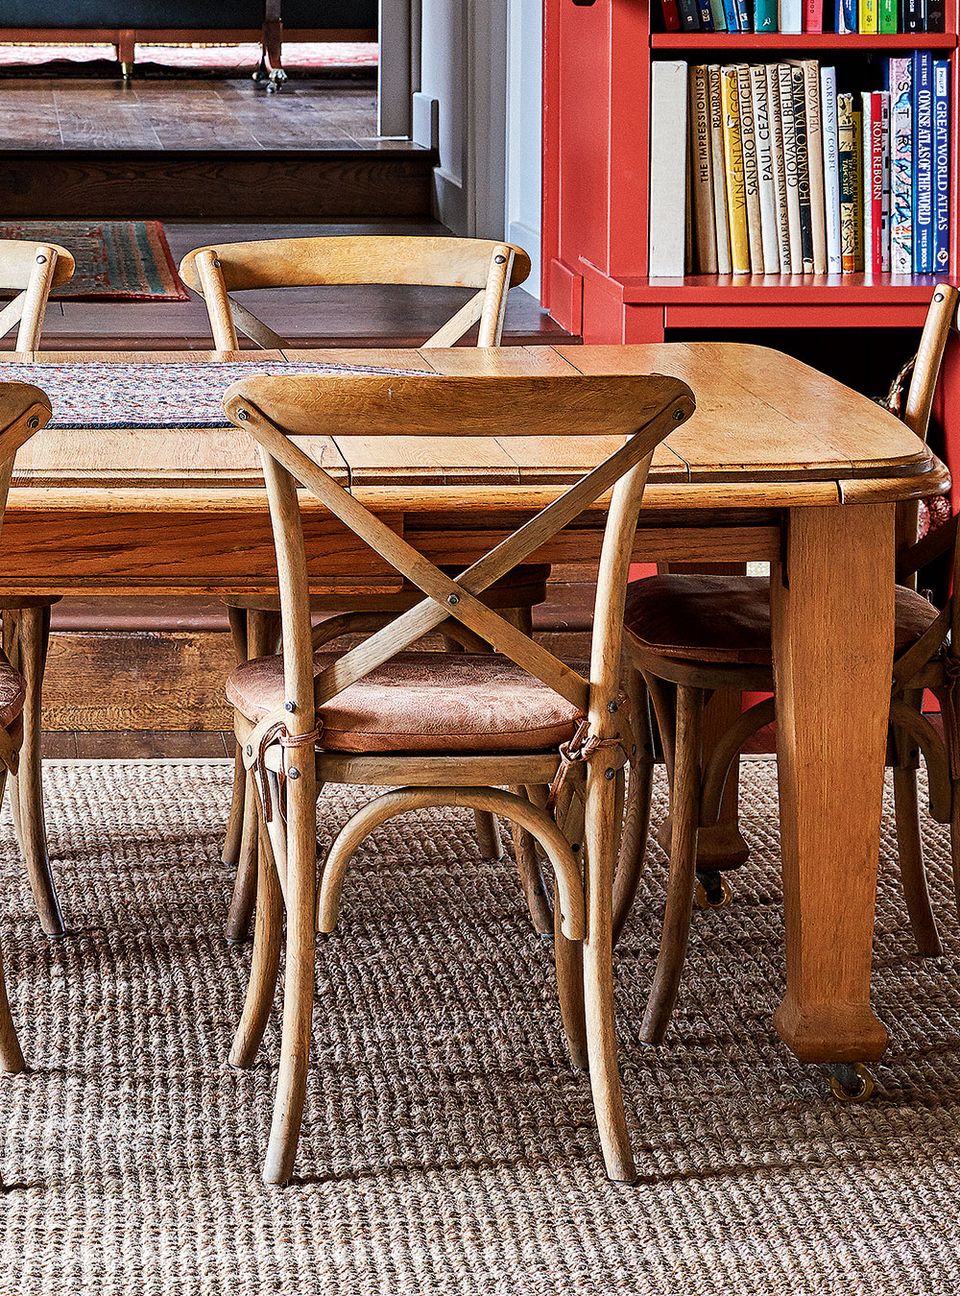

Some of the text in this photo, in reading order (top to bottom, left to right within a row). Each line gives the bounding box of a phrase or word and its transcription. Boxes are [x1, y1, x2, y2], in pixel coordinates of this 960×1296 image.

[710, 69, 721, 128] REMBRANDT
[771, 69, 780, 122] DRAWINGS
[807, 65, 819, 135] VELAZQUEZ
[824, 77, 833, 123] GARDENS
[918, 90, 930, 128] CONCISE
[696, 69, 709, 182] THE IMPRESSIONISTS
[754, 70, 773, 181] PAUL CEZANNE
[775, 127, 783, 149] AND
[779, 67, 798, 187] GIOVANNI BELLINI
[918, 128, 930, 159] ATLAS
[743, 139, 758, 195] SANDRO
[827, 137, 835, 172] CORFU
[872, 121, 882, 200] ROME REBORN
[918, 170, 931, 187] THE
[936, 101, 948, 231] GREAT WORLD ATLAS
[918, 188, 931, 225] WORLD
